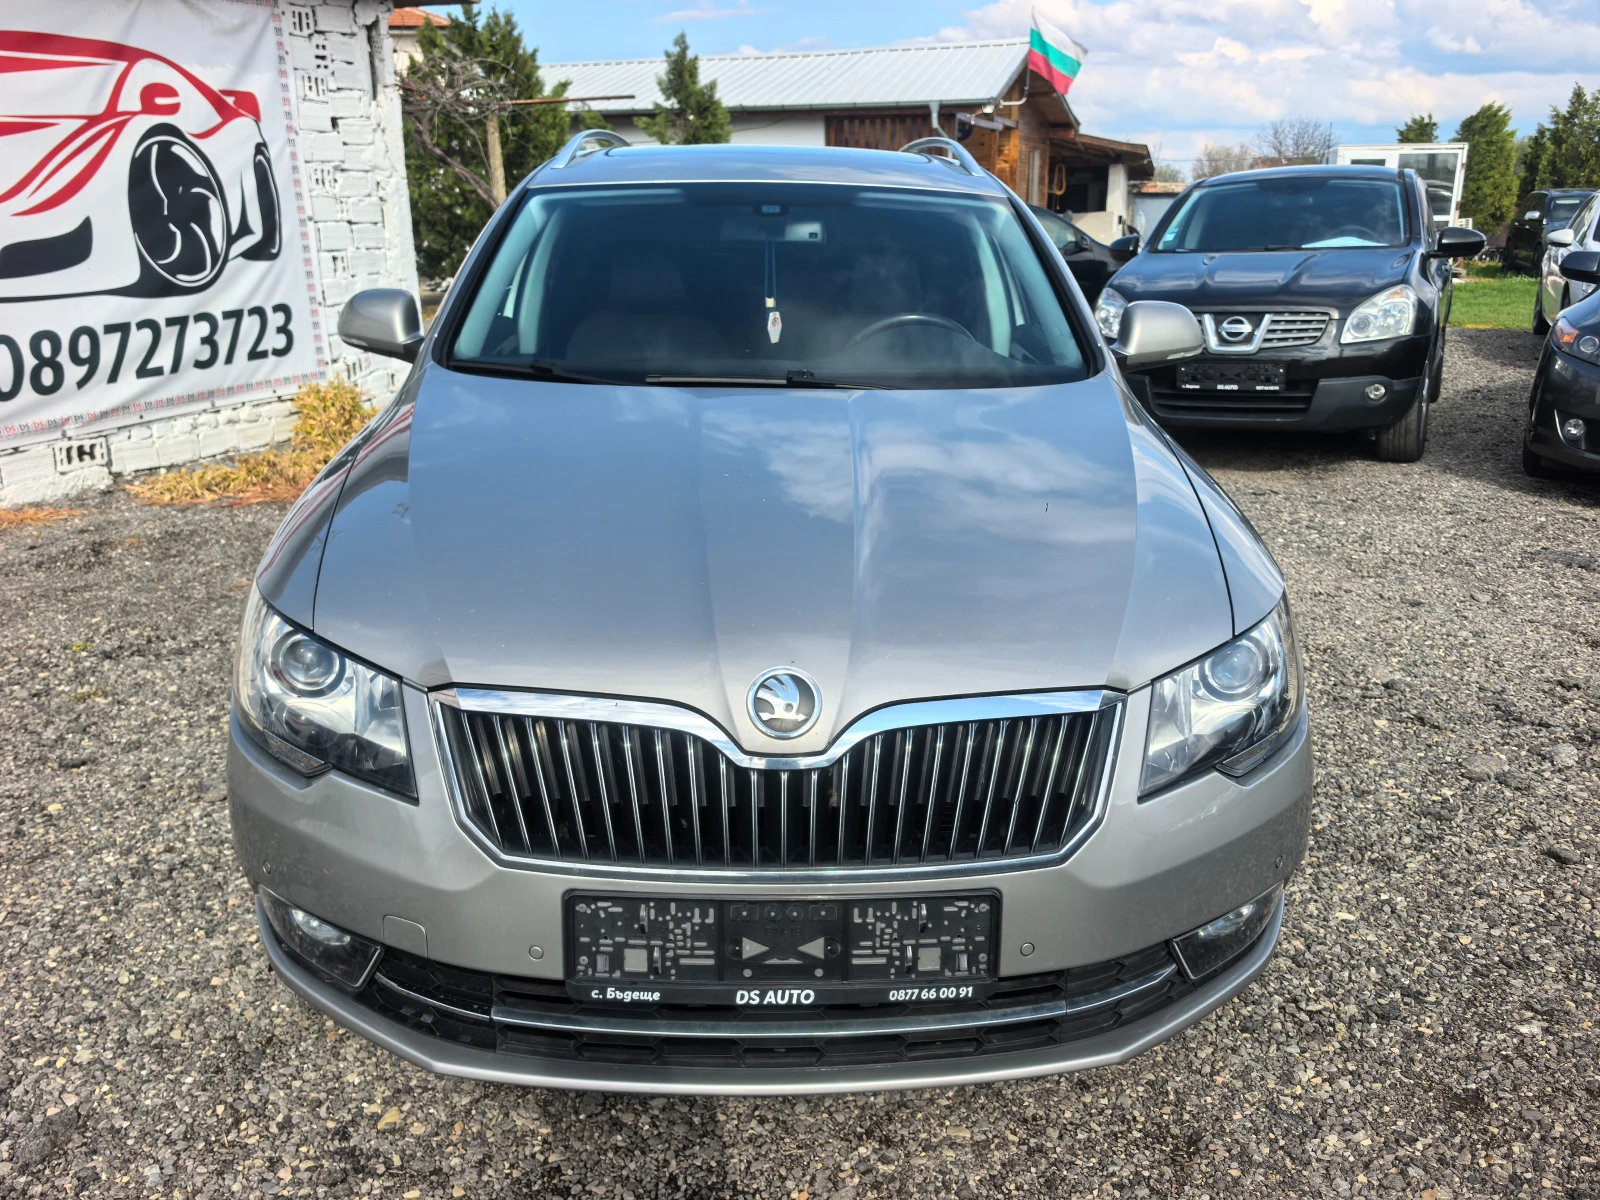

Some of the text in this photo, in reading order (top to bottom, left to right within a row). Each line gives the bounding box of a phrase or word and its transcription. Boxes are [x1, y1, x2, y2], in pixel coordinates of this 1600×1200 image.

[0, 303, 294, 402] 0897273723
[607, 987, 660, 1002] Бъдеще
[736, 989, 815, 1004] DS AUTO
[889, 986, 974, 1001] 0877 66 00 91
